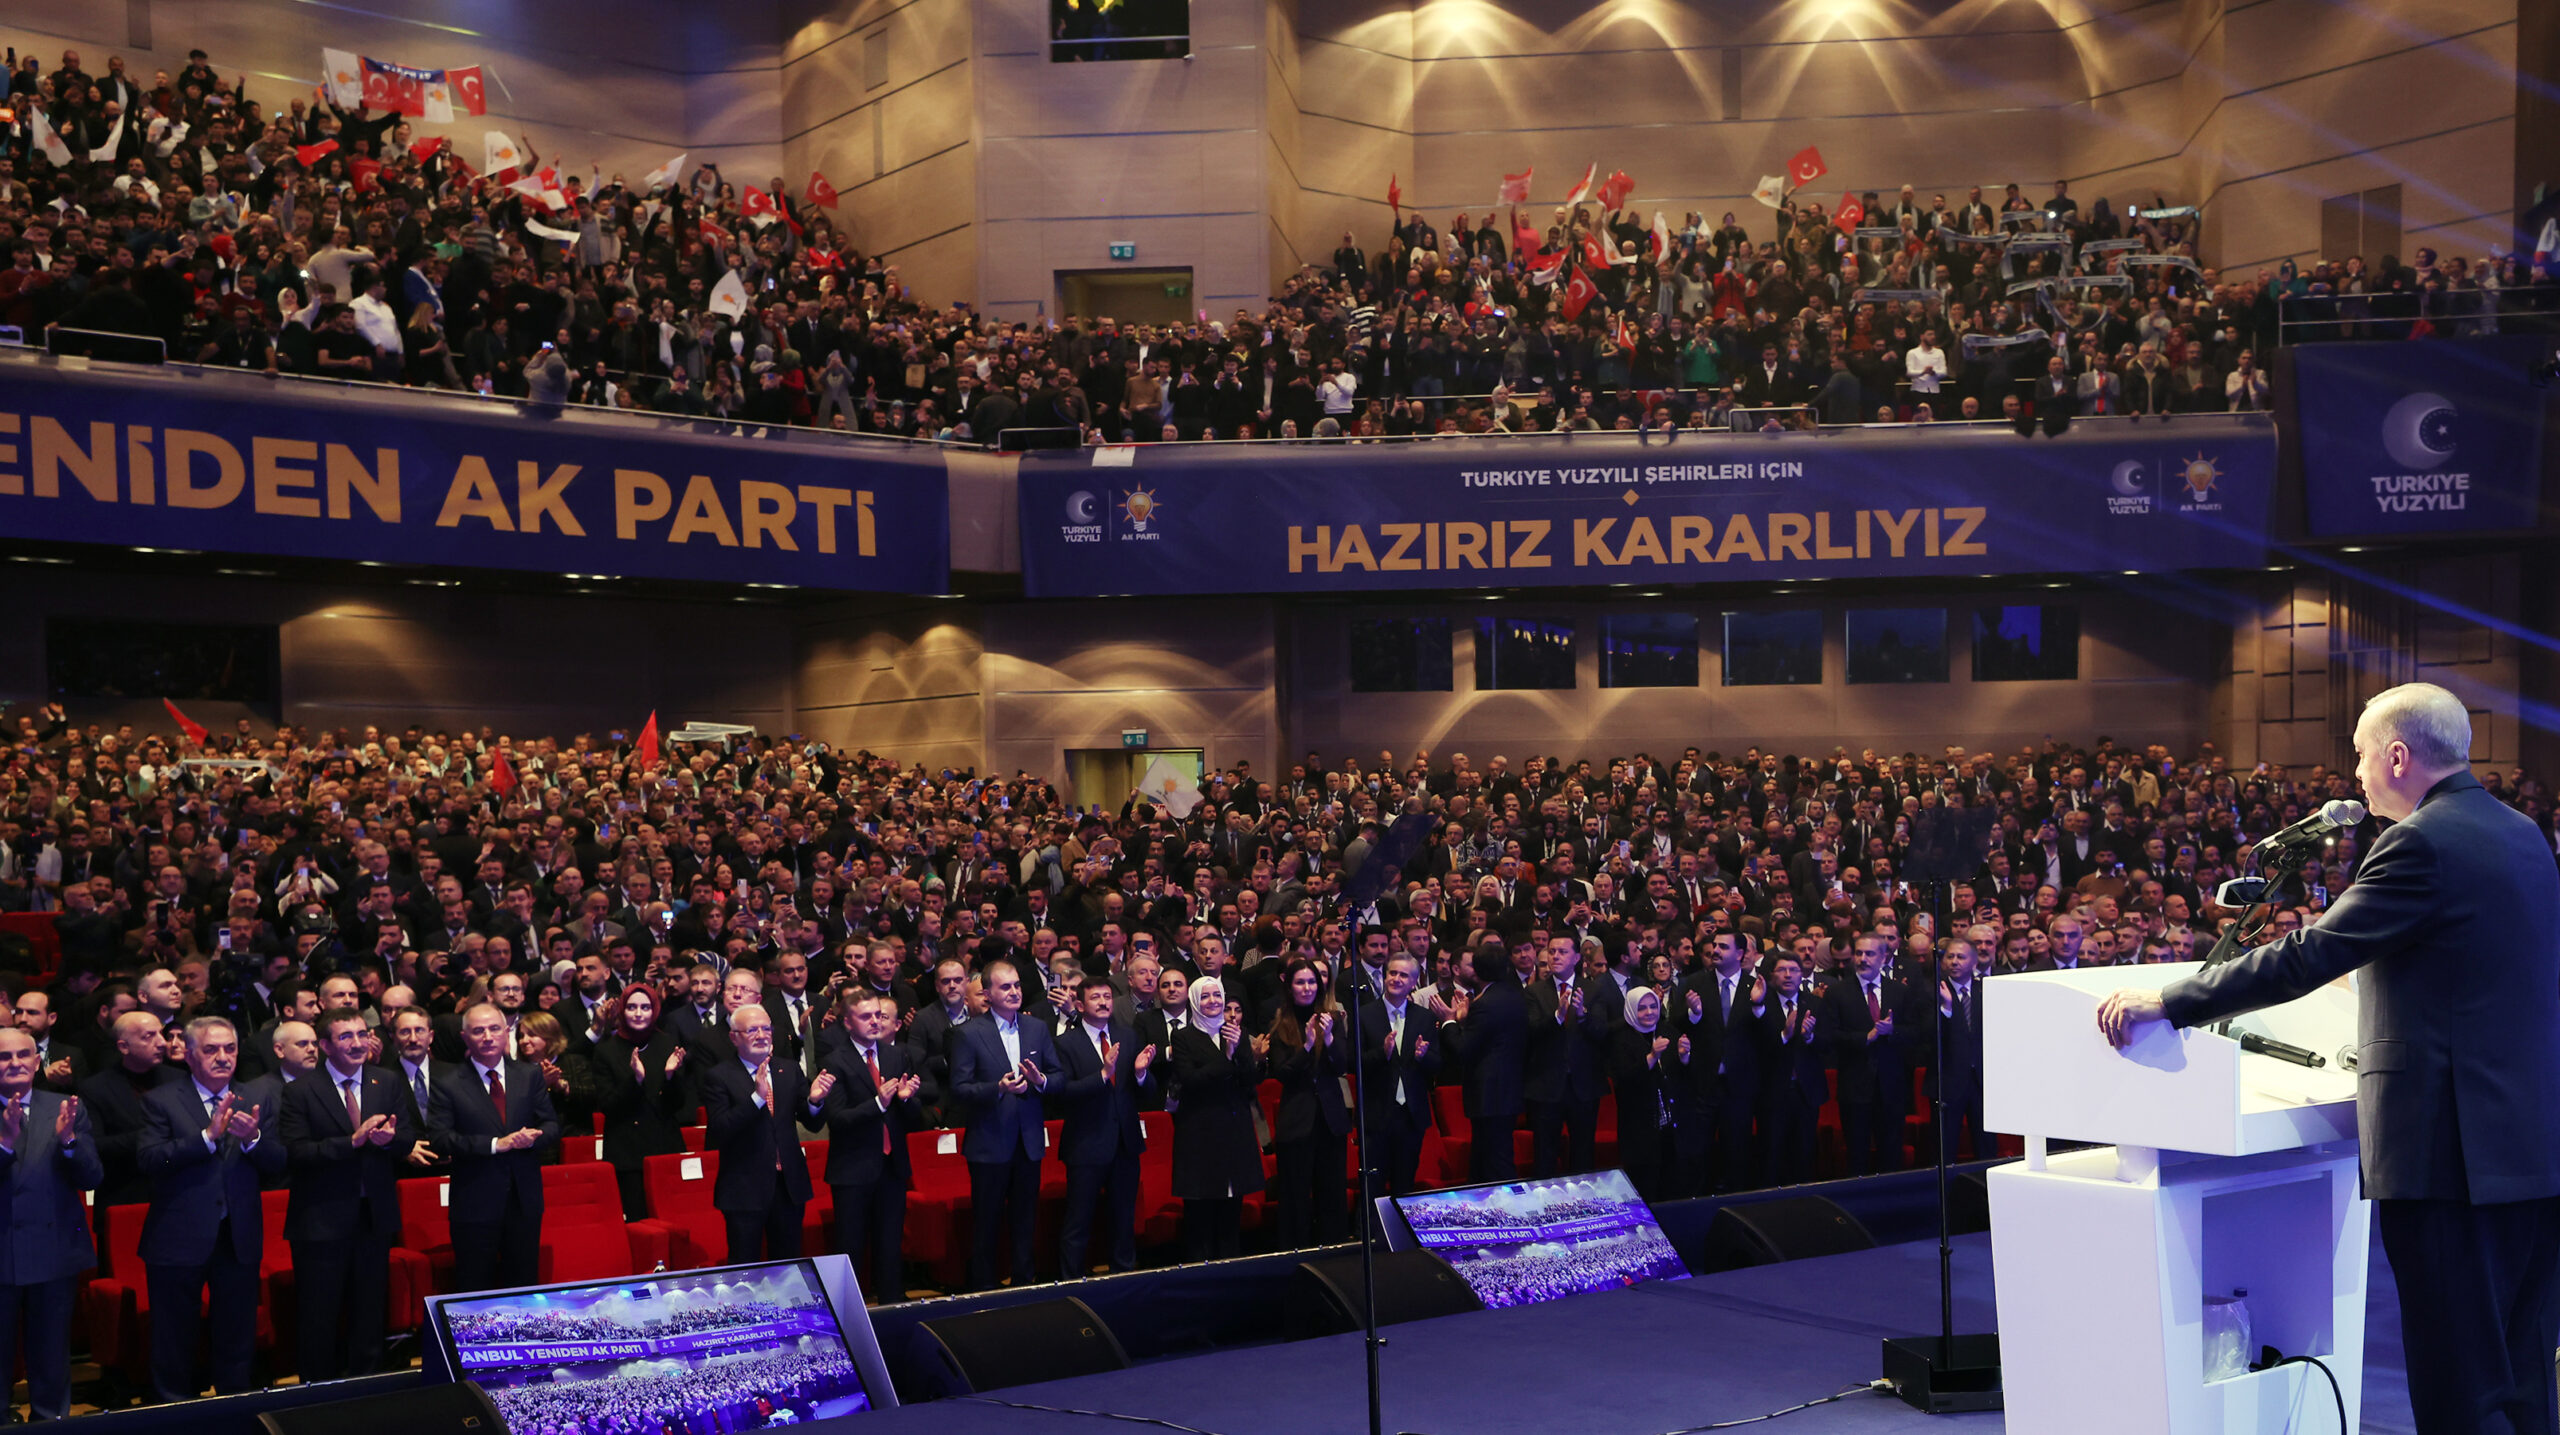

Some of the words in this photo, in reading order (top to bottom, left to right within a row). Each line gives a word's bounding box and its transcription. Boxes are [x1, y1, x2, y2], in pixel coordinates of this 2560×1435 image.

[435, 454, 587, 537] AK
[614, 468, 877, 557] PARTİ
[1288, 519, 1552, 573] HAZIRIZ
[1573, 507, 1988, 567] KARARLIYIZ
[458, 1349, 523, 1363] ANBUL
[592, 1346, 608, 1356] AK
[692, 1337, 727, 1348] HAZIRIZ
[727, 1330, 777, 1343] KARARLIYIZ
